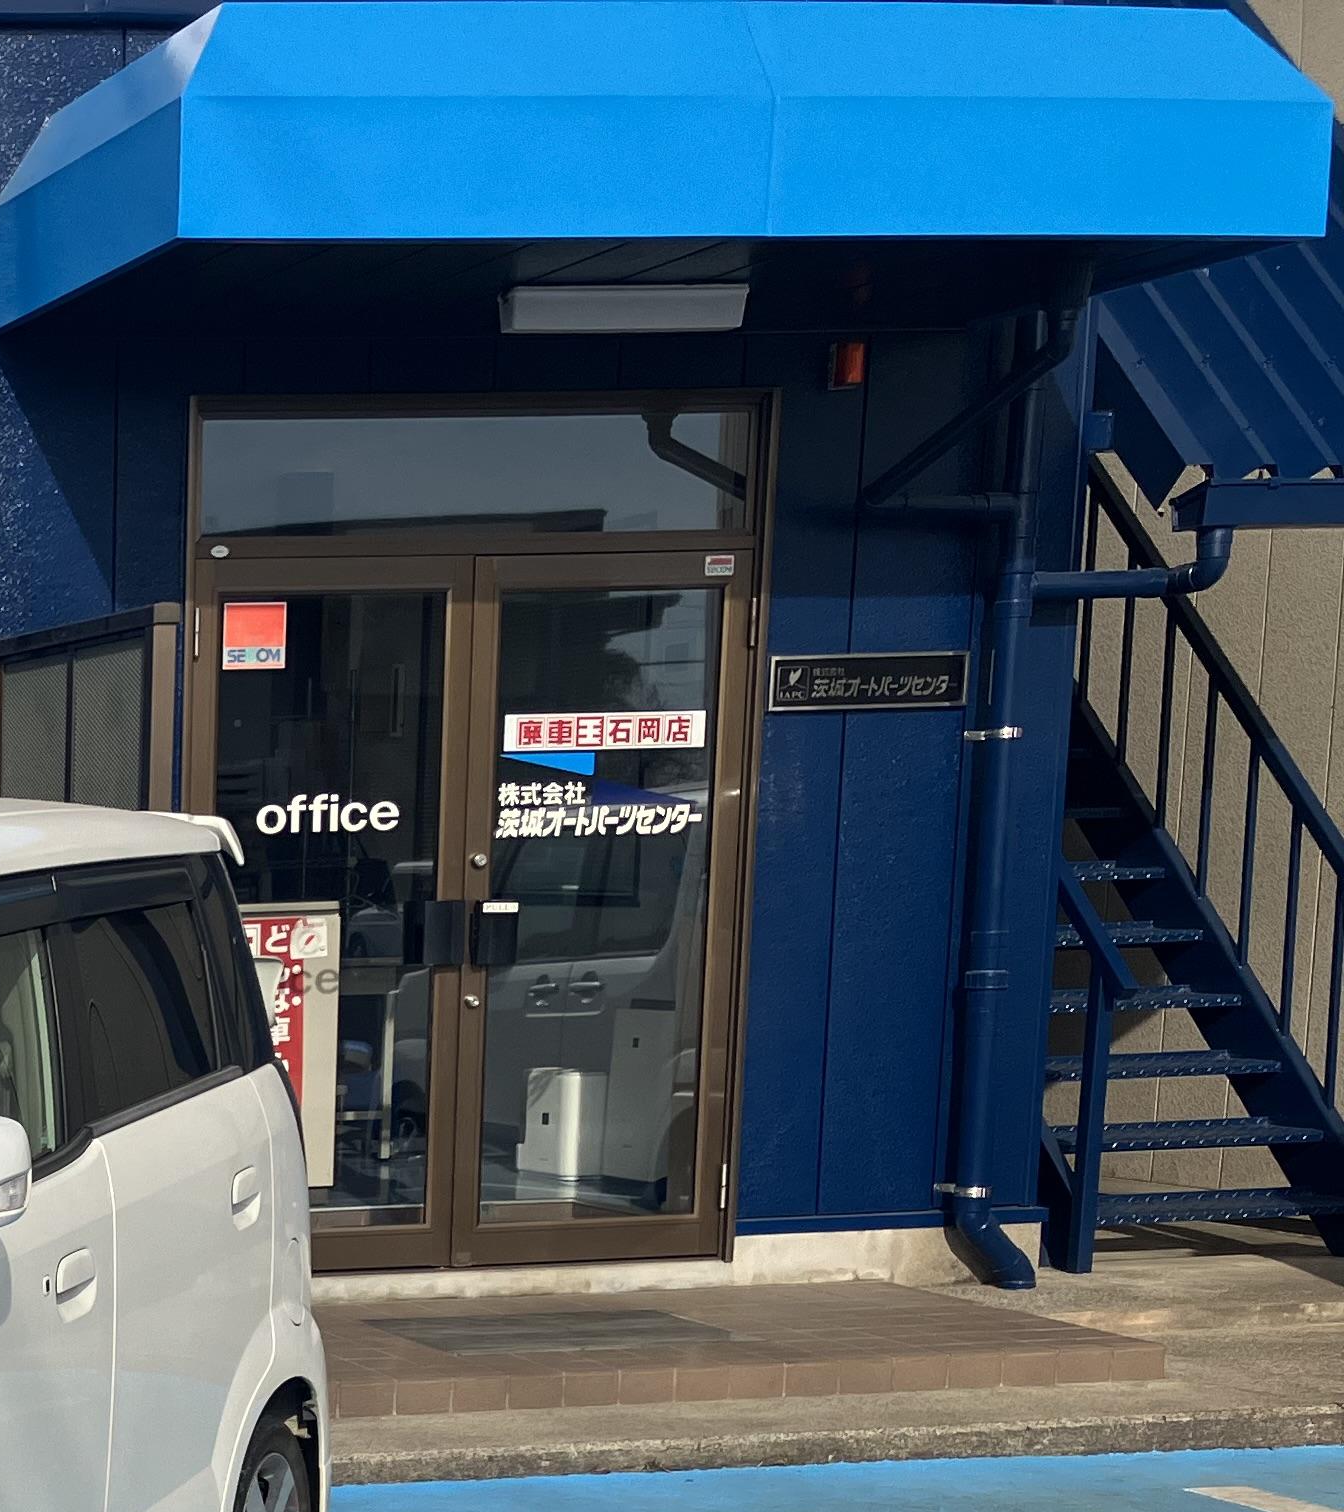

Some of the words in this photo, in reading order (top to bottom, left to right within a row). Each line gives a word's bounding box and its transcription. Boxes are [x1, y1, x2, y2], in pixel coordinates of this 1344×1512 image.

[227, 648, 281, 663] SEOM
[812, 674, 958, 698] 茨城オートパーツセンター
[518, 715, 691, 747] 廃車王石岡店
[498, 781, 586, 806] 株式会社
[255, 793, 400, 835] office
[495, 803, 703, 839] 茨城オートパーツセンター
